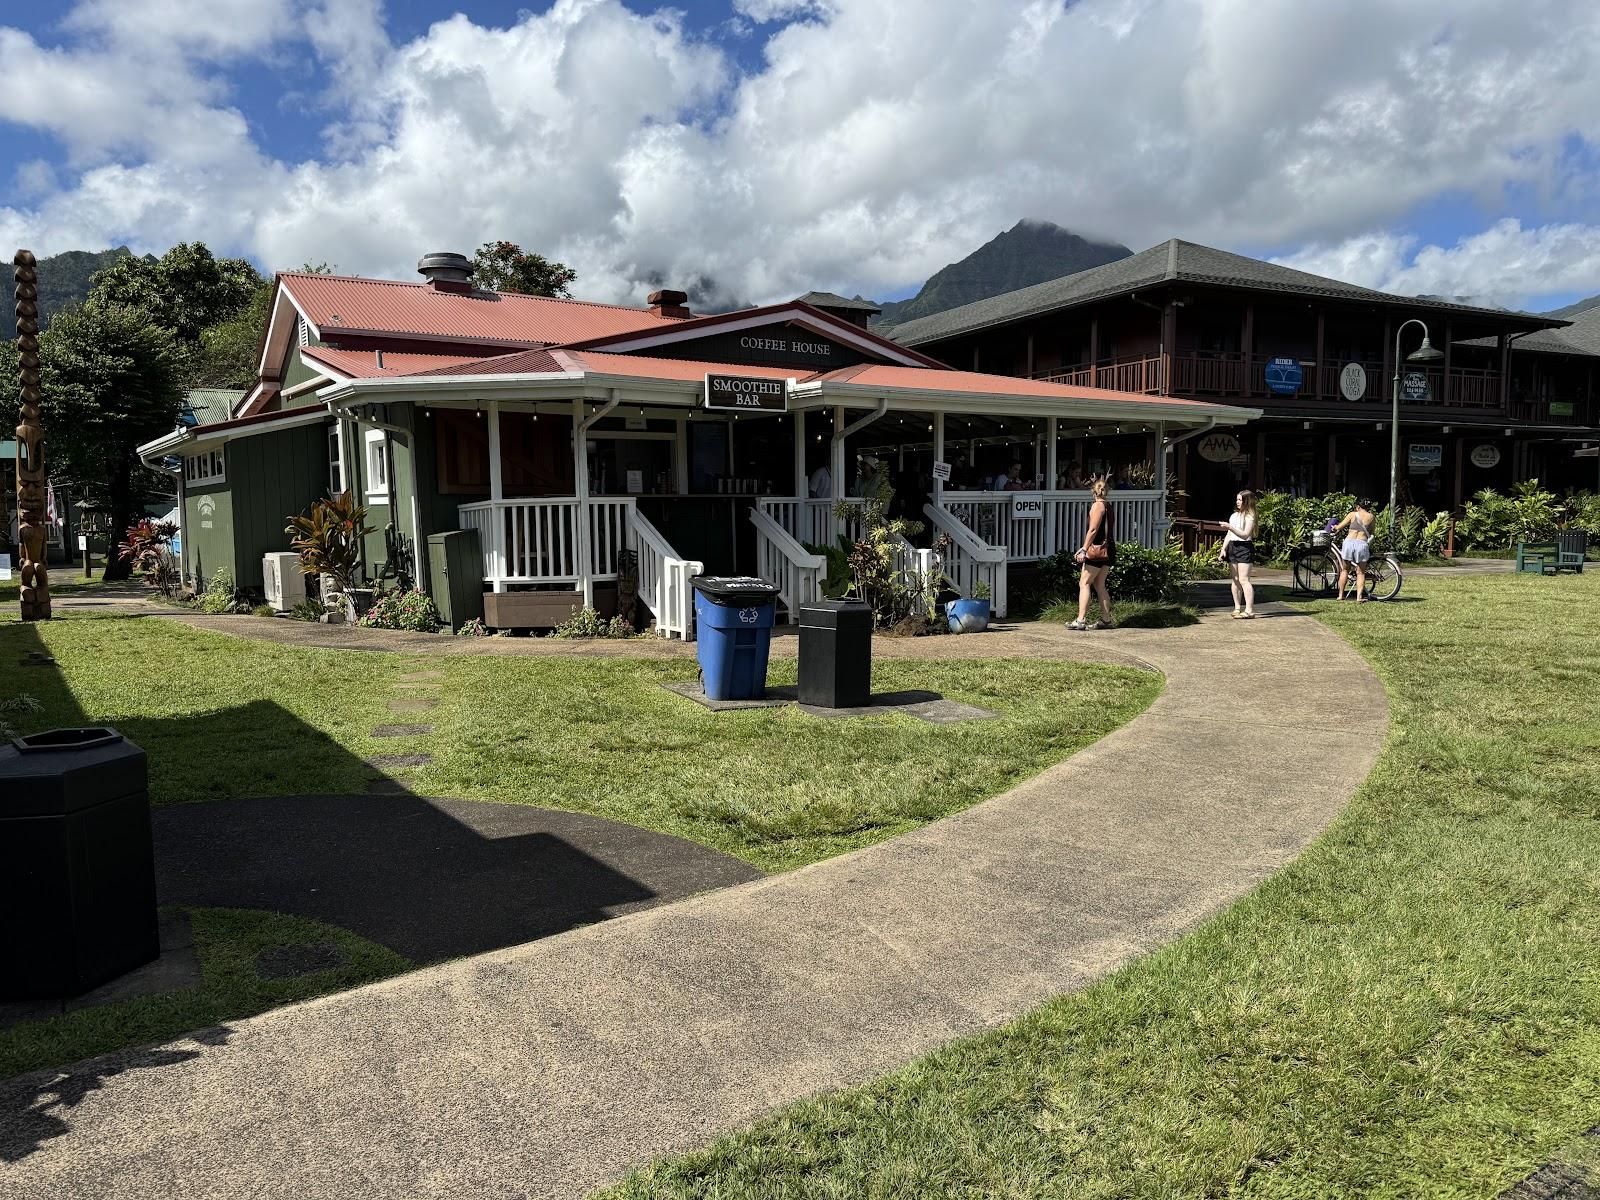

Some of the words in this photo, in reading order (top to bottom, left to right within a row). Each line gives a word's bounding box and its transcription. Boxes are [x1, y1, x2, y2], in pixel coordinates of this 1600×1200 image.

[740, 337, 787, 351] COFFEE
[791, 342, 831, 355] HOUSE
[1345, 368, 1360, 377] BLACK
[713, 380, 781, 395] SMOOTHIE
[1345, 387, 1361, 396] YOGA
[735, 394, 761, 406] BAR
[1015, 502, 1041, 511] OPEN
